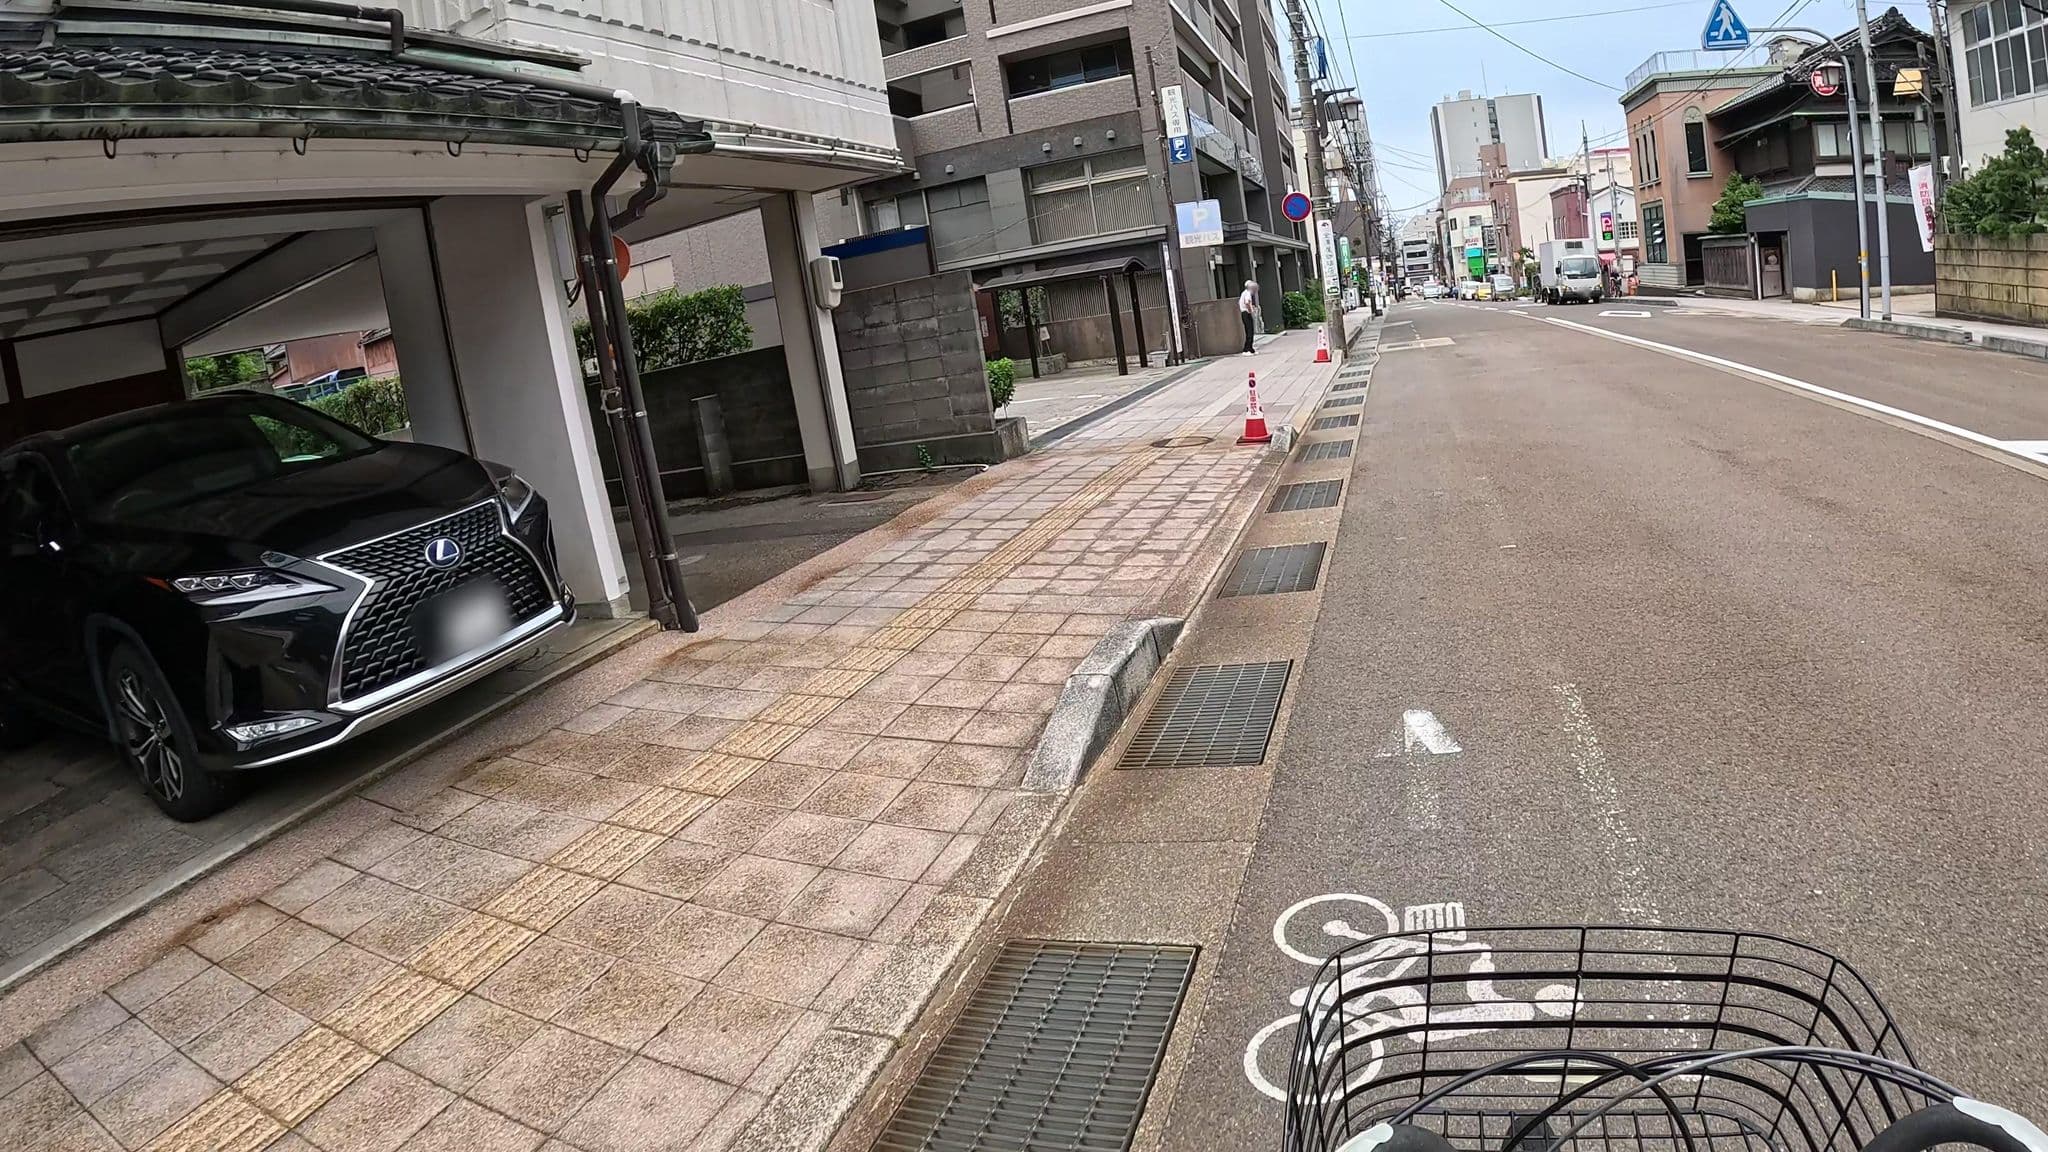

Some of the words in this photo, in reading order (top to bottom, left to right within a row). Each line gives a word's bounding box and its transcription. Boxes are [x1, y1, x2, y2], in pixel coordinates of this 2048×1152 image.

[1174, 139, 1184, 149] P
[1192, 208, 1208, 228] P
[1184, 232, 1220, 245] 観光バス
